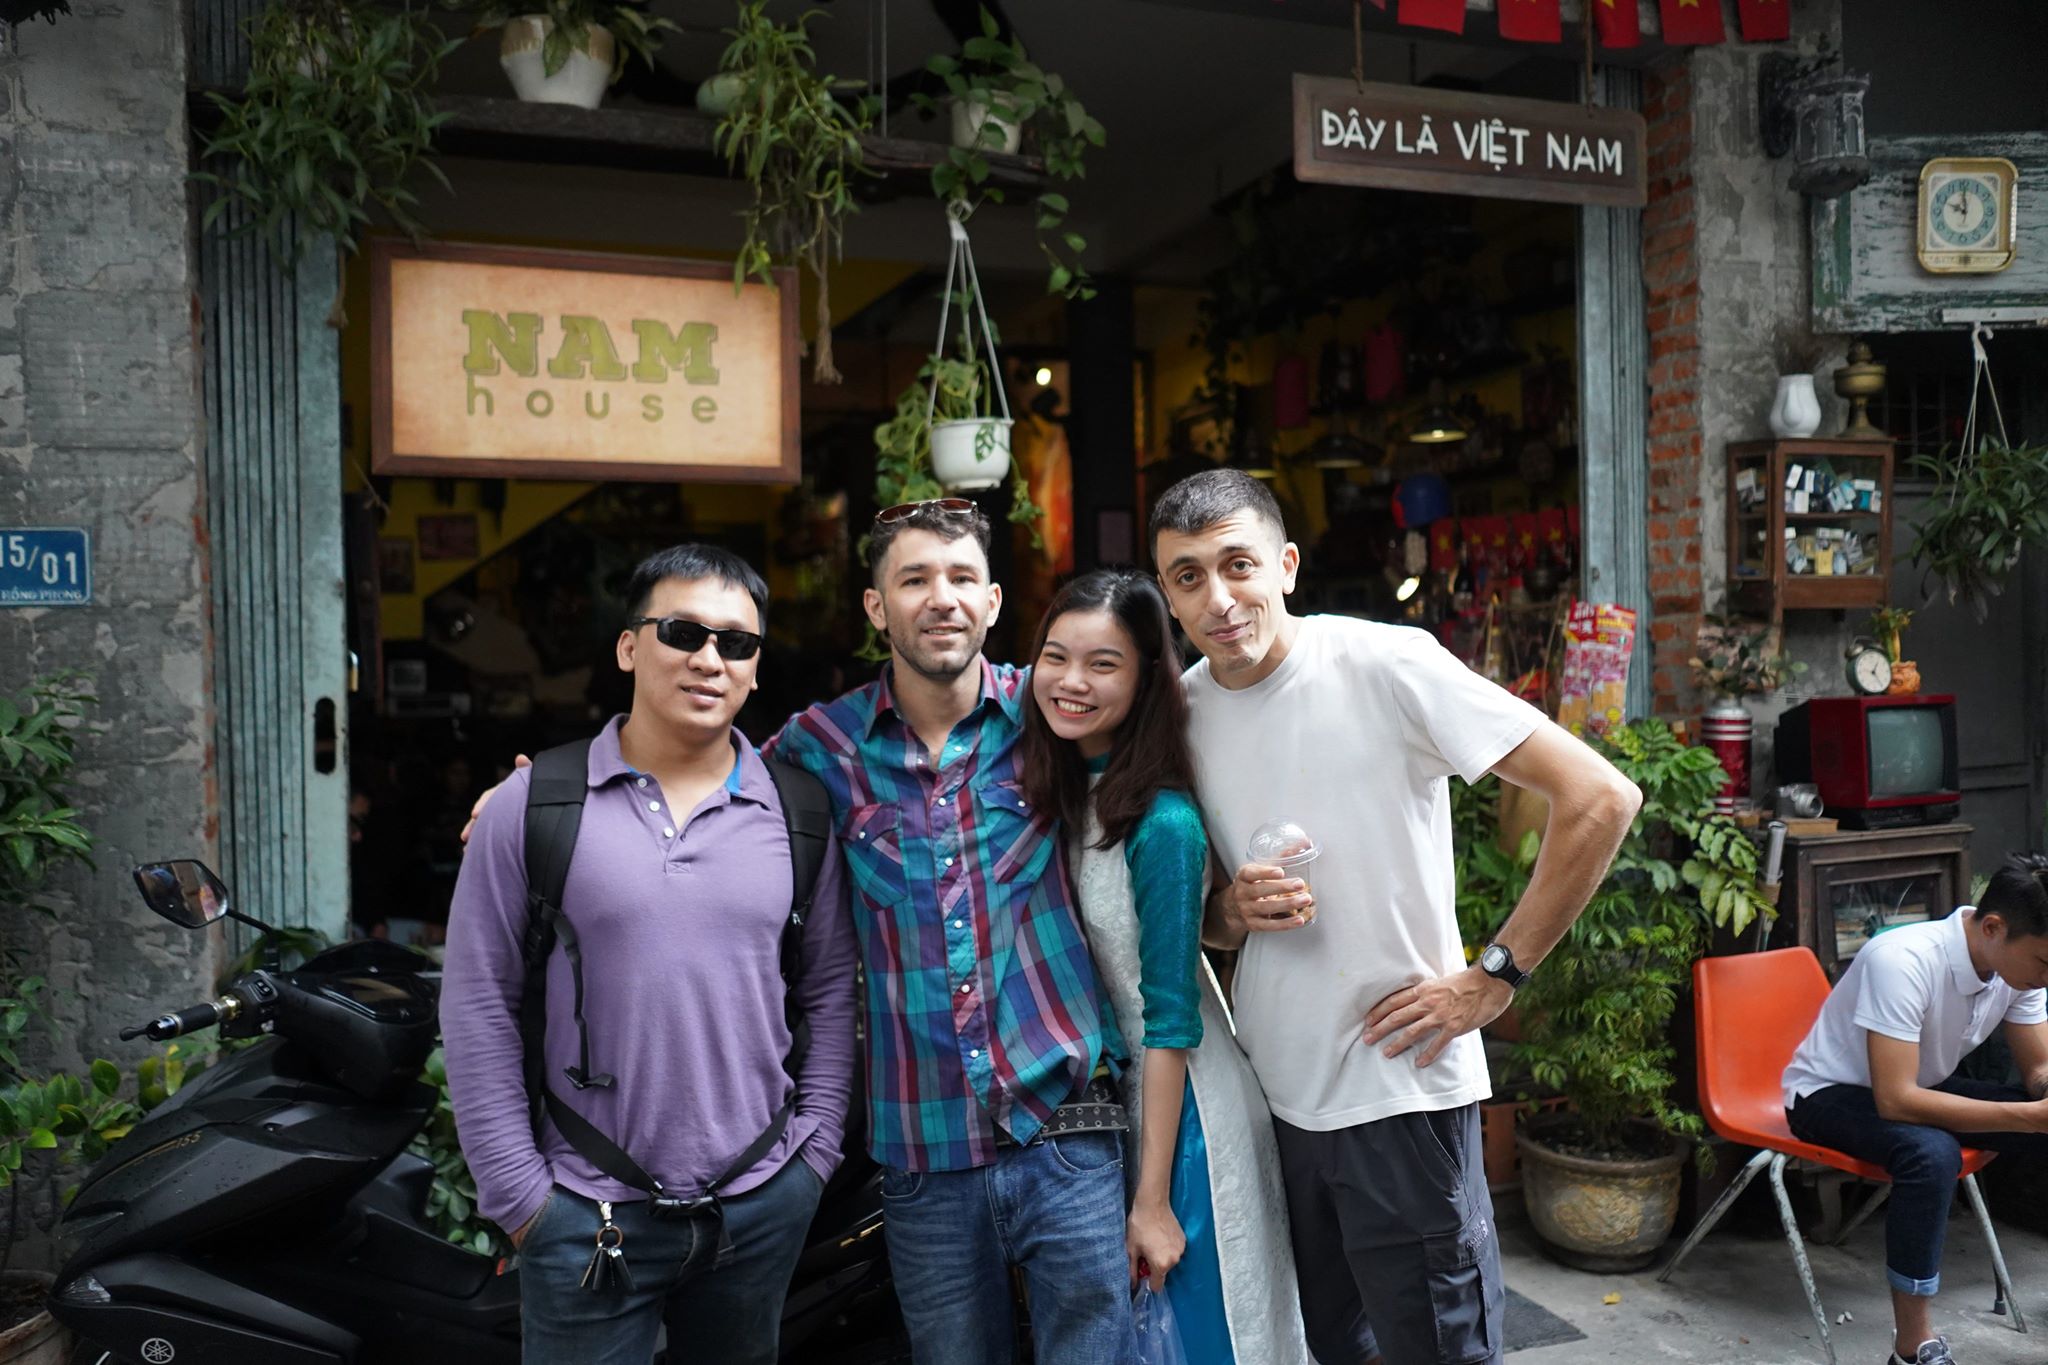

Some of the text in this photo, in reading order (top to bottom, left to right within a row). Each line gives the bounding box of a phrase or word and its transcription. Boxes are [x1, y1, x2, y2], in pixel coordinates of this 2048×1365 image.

[1321, 107, 1623, 176] ĐÂY LÀ VIỆT NAM
[462, 308, 719, 386] NAM
[466, 372, 718, 423] house
